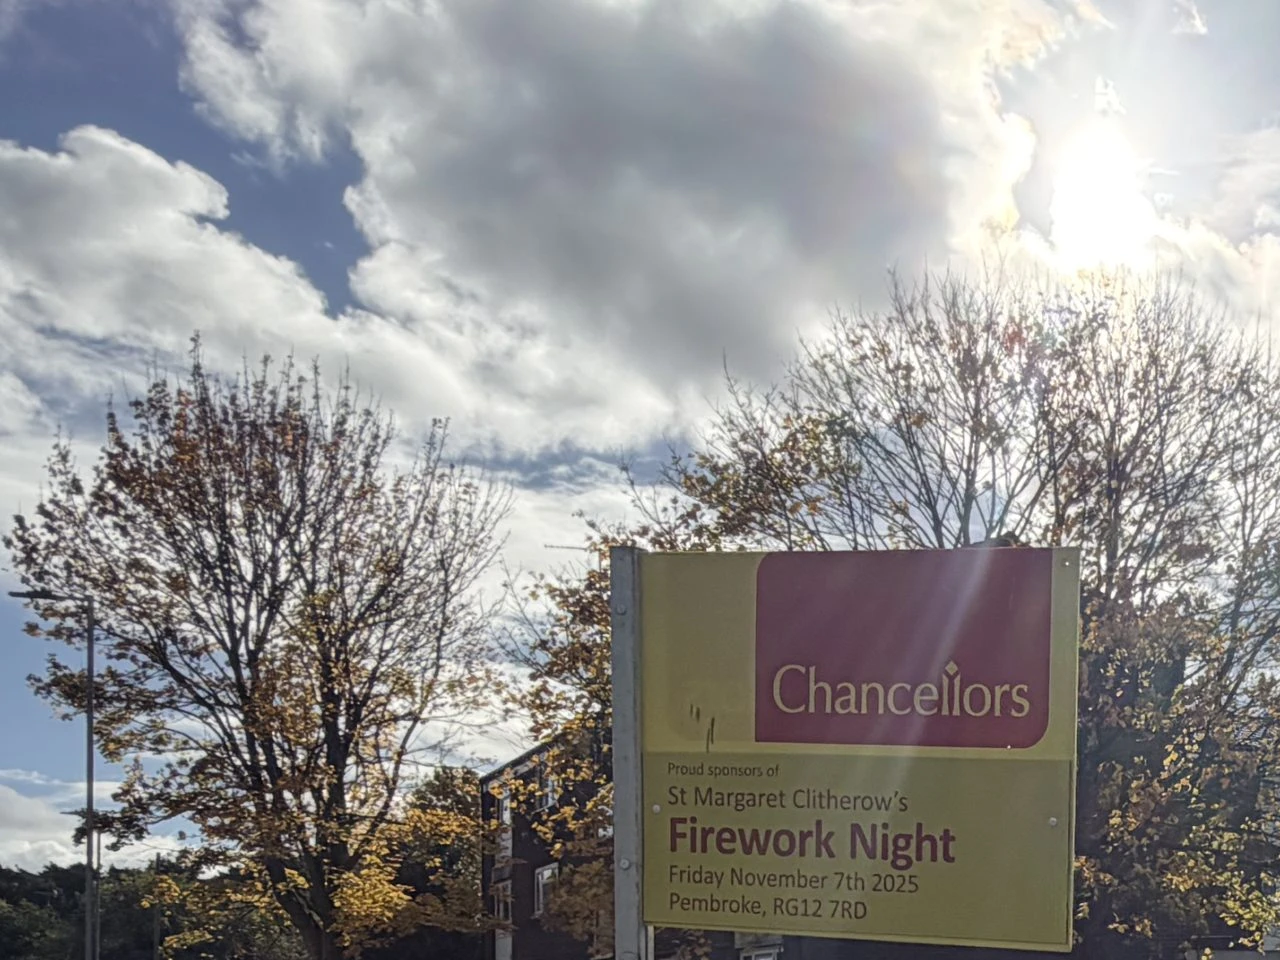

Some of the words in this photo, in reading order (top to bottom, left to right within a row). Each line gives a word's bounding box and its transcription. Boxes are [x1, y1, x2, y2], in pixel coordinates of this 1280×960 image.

[772, 660, 1030, 718] Chancellors
[667, 762, 704, 776] Proud
[707, 766, 763, 780] sponsors
[766, 764, 780, 778] of
[668, 786, 687, 805] St
[694, 787, 786, 813] Margaret
[792, 789, 908, 812] Clitherow's
[669, 816, 836, 859] Firework
[849, 823, 956, 870] Night
[669, 865, 725, 889] Friday
[730, 868, 828, 890] November
[834, 872, 866, 892] 7th
[871, 874, 920, 893] 2025
[669, 893, 767, 917] Pembroke,
[773, 900, 822, 917] RG12
[829, 901, 868, 920] 7RD
